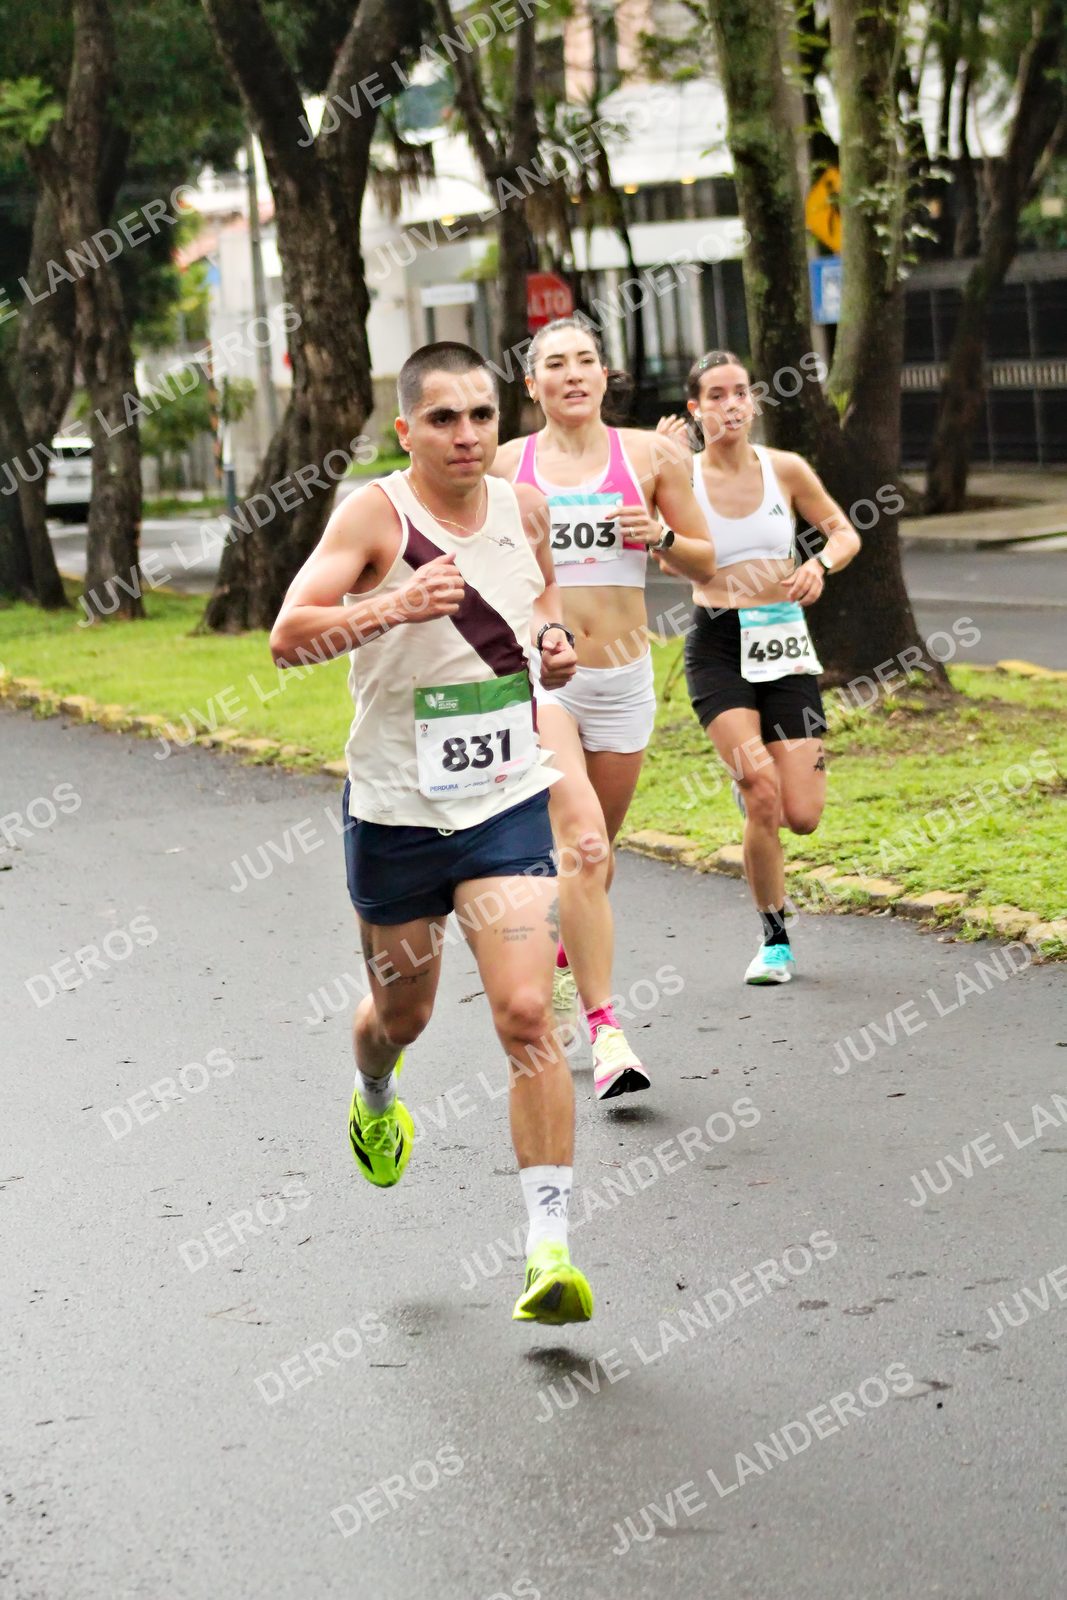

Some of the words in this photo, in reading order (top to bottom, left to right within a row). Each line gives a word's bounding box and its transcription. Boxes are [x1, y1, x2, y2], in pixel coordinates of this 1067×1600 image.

[551, 522, 616, 550] 303
[748, 635, 809, 662] 4982
[442, 728, 511, 772] 831
